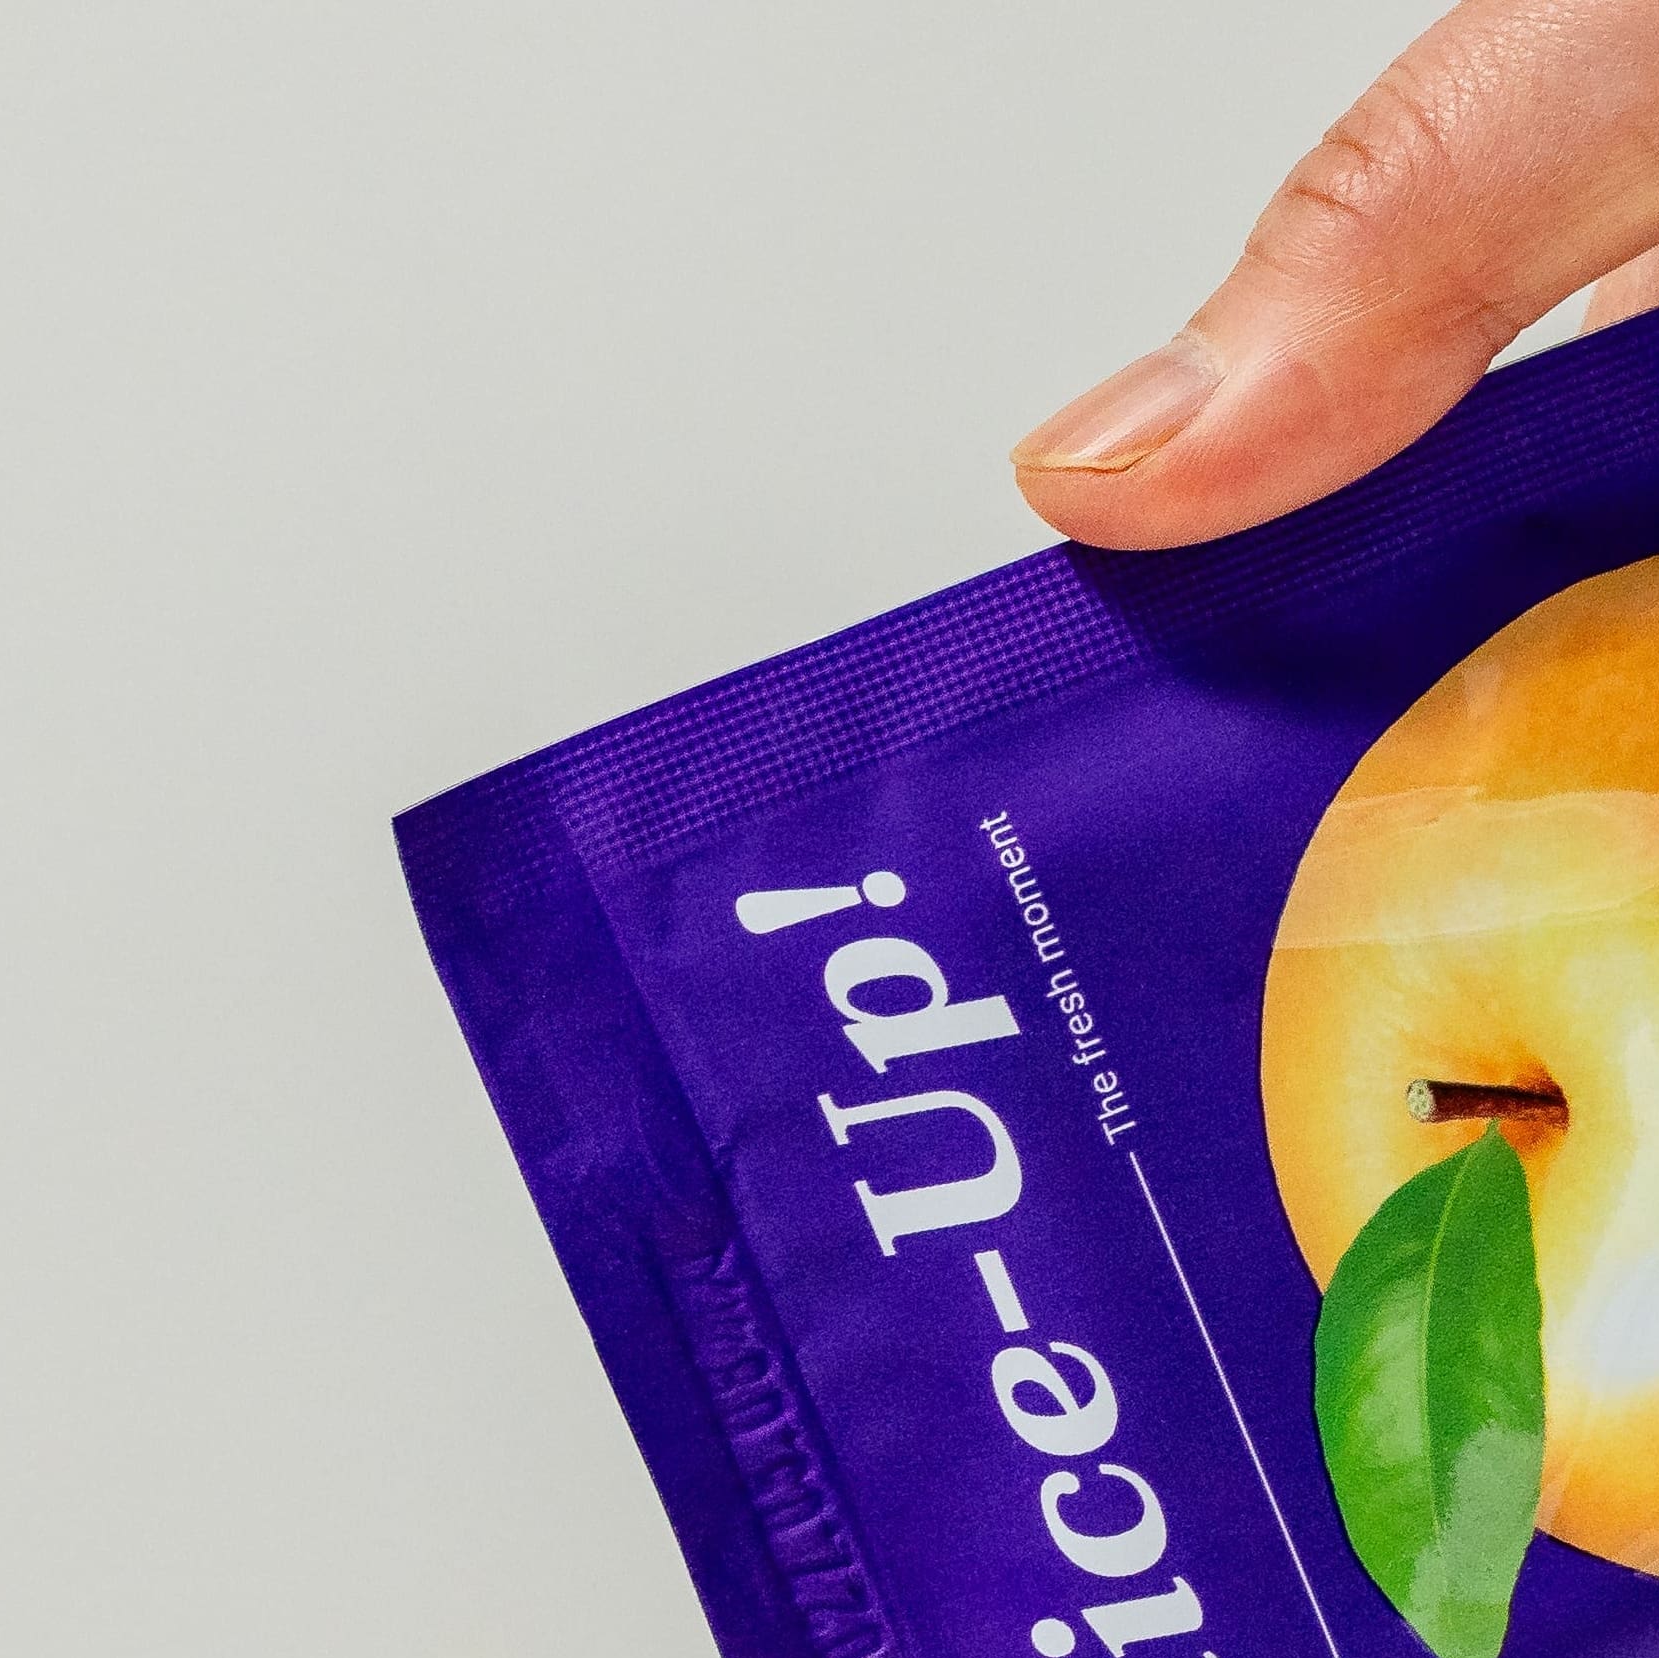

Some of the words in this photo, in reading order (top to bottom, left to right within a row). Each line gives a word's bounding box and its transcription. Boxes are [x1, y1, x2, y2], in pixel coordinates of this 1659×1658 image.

[979, 810, 1066, 964] moment
[1046, 968, 1107, 1067] fresh
[1102, 1070, 1138, 1147] The
